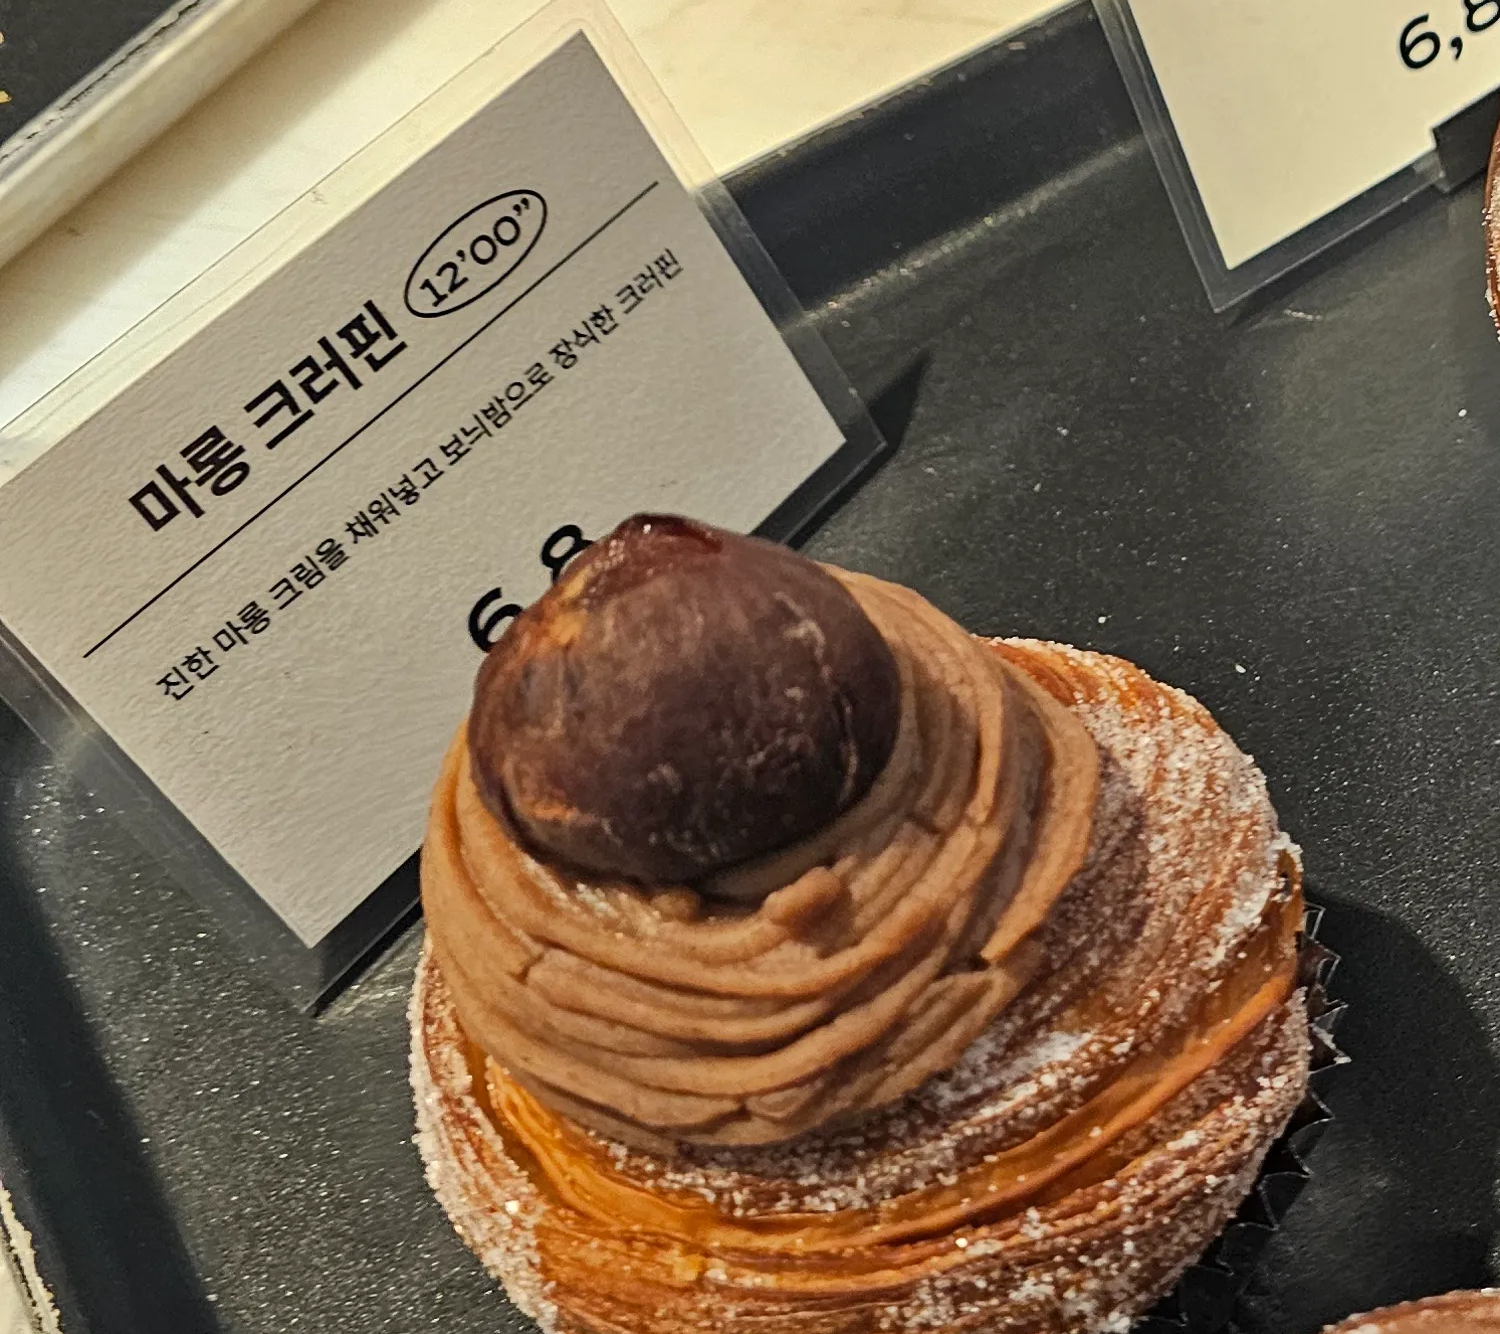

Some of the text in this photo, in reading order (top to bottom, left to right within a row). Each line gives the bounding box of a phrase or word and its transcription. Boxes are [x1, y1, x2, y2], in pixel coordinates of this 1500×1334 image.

[127, 422, 252, 533] 마롱
[242, 299, 408, 450] 크러핀
[155, 247, 685, 701] 진한 마롱 크림을 채워넣고 보늬밤으로 장식한 크러핀
